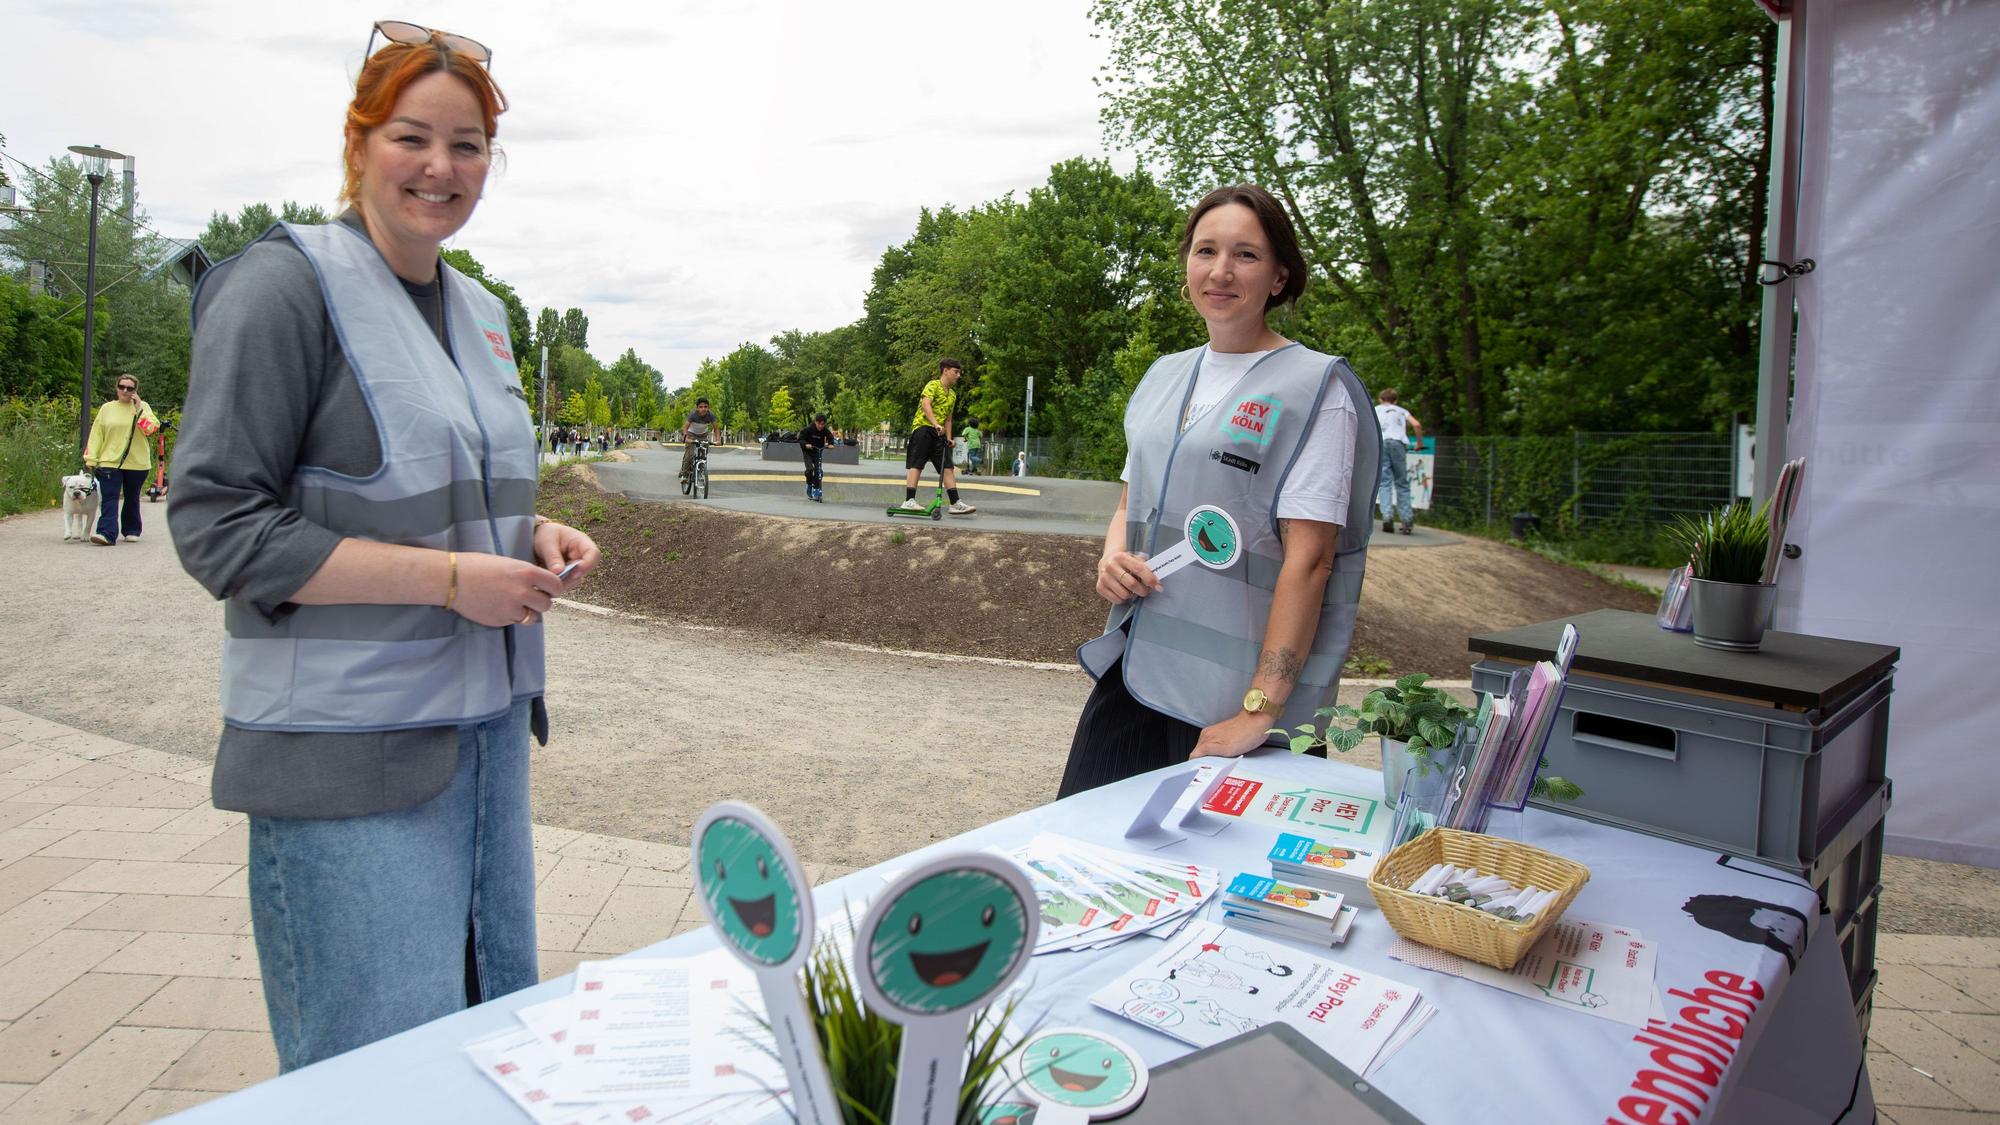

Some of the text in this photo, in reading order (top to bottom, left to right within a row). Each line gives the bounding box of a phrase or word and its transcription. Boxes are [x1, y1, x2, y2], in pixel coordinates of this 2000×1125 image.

[1236, 400, 1270, 419] HEY
[1230, 414, 1265, 434] KÖLN
[1311, 798, 1332, 813] Porz
[1335, 802, 1361, 821] HEY
[1306, 973, 1361, 1023] Hey Porz!
[1604, 969, 1766, 1125] endliche
